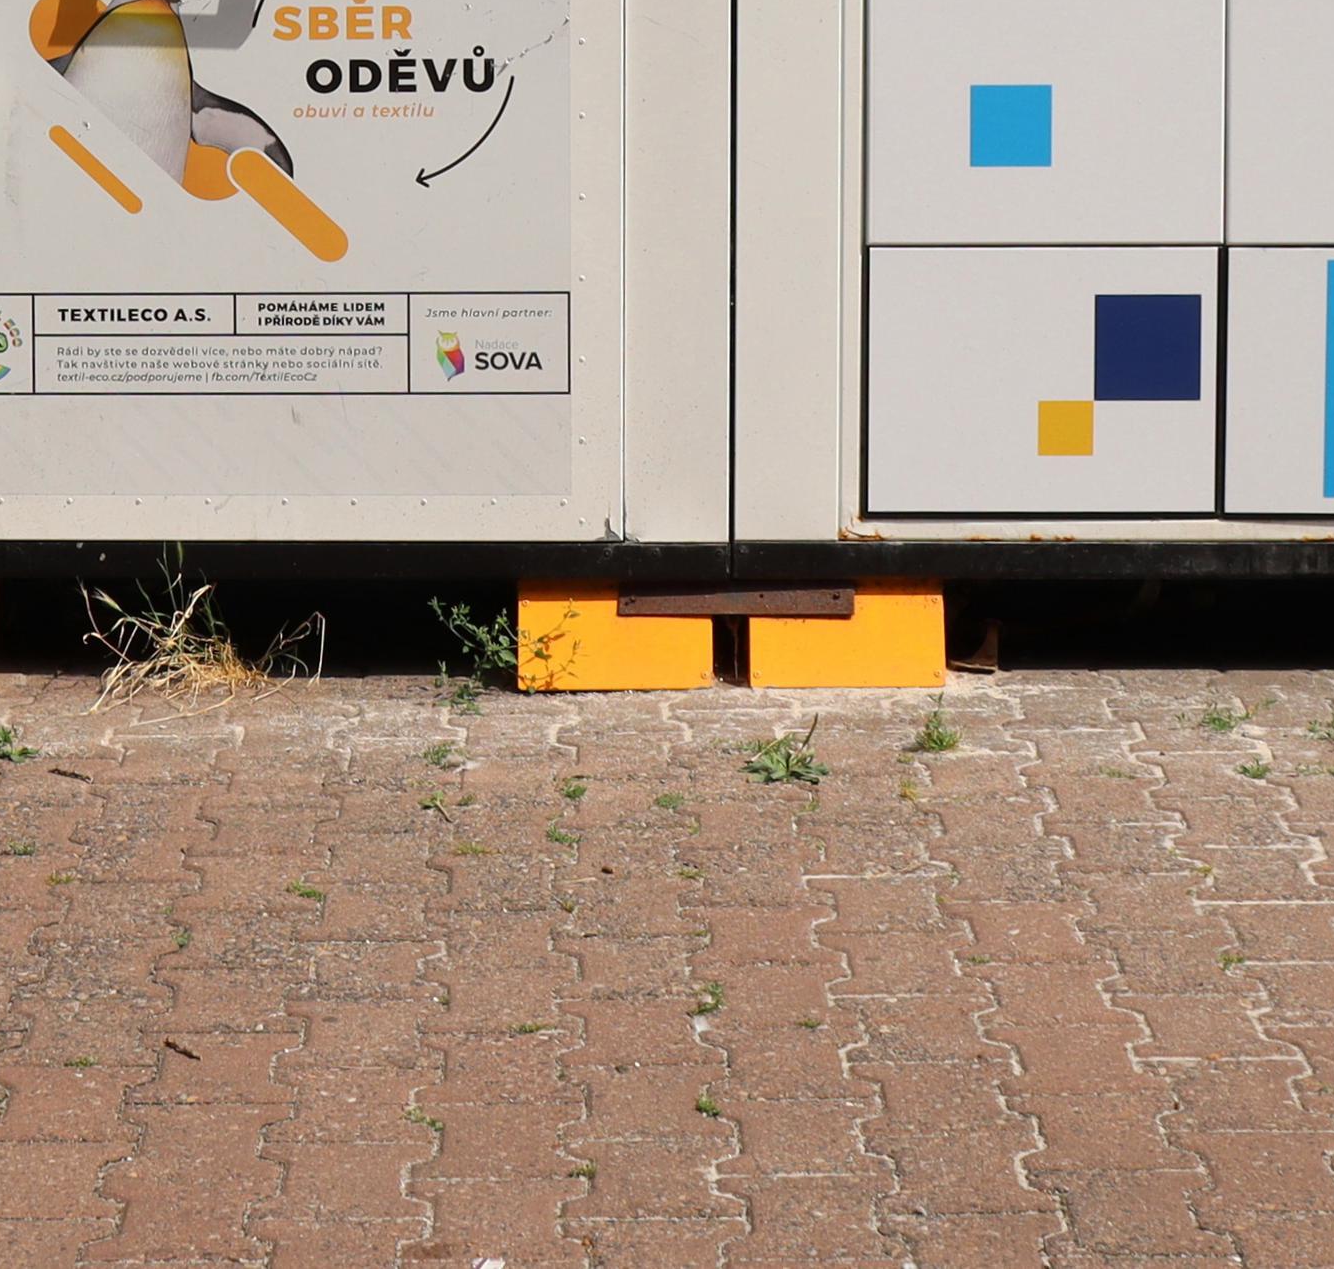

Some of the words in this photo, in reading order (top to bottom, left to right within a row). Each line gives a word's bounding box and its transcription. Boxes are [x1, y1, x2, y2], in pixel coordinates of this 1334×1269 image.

[305, 46, 495, 94] ODĚVŮ
[292, 103, 348, 119] obuvi
[352, 107, 365, 118] a
[371, 102, 435, 118] textilu
[258, 301, 338, 312] POMÁHÁME
[343, 302, 385, 312] LIDEM
[58, 308, 168, 322] TEXTILECO
[174, 308, 212, 322] A.S.
[265, 314, 320, 326] PŘÍRODĚ
[323, 314, 353, 326] DÍKY
[356, 314, 385, 326] VÁM
[425, 308, 458, 318] Jsme
[462, 307, 499, 318] hlavní
[502, 307, 553, 320] partner:
[475, 339, 519, 349] Nadace
[57, 346, 83, 356] Rádi
[87, 346, 100, 358] by
[104, 347, 122, 356] ste
[125, 348, 138, 356] se
[202, 346, 229, 357] více,
[232, 346, 262, 356] nebo
[266, 346, 297, 356] máte
[300, 345, 335, 358] dobrý
[339, 345, 383, 358] nápad?
[57, 359, 78, 369] Tak
[141, 359, 169, 369] naše
[173, 359, 220, 369] webové
[223, 359, 268, 371] stránky
[272, 359, 303, 369] nebo
[307, 358, 354, 369] sociální
[474, 351, 543, 371] SOVA
[57, 371, 203, 383] textil-eco.cz/podporujeme
